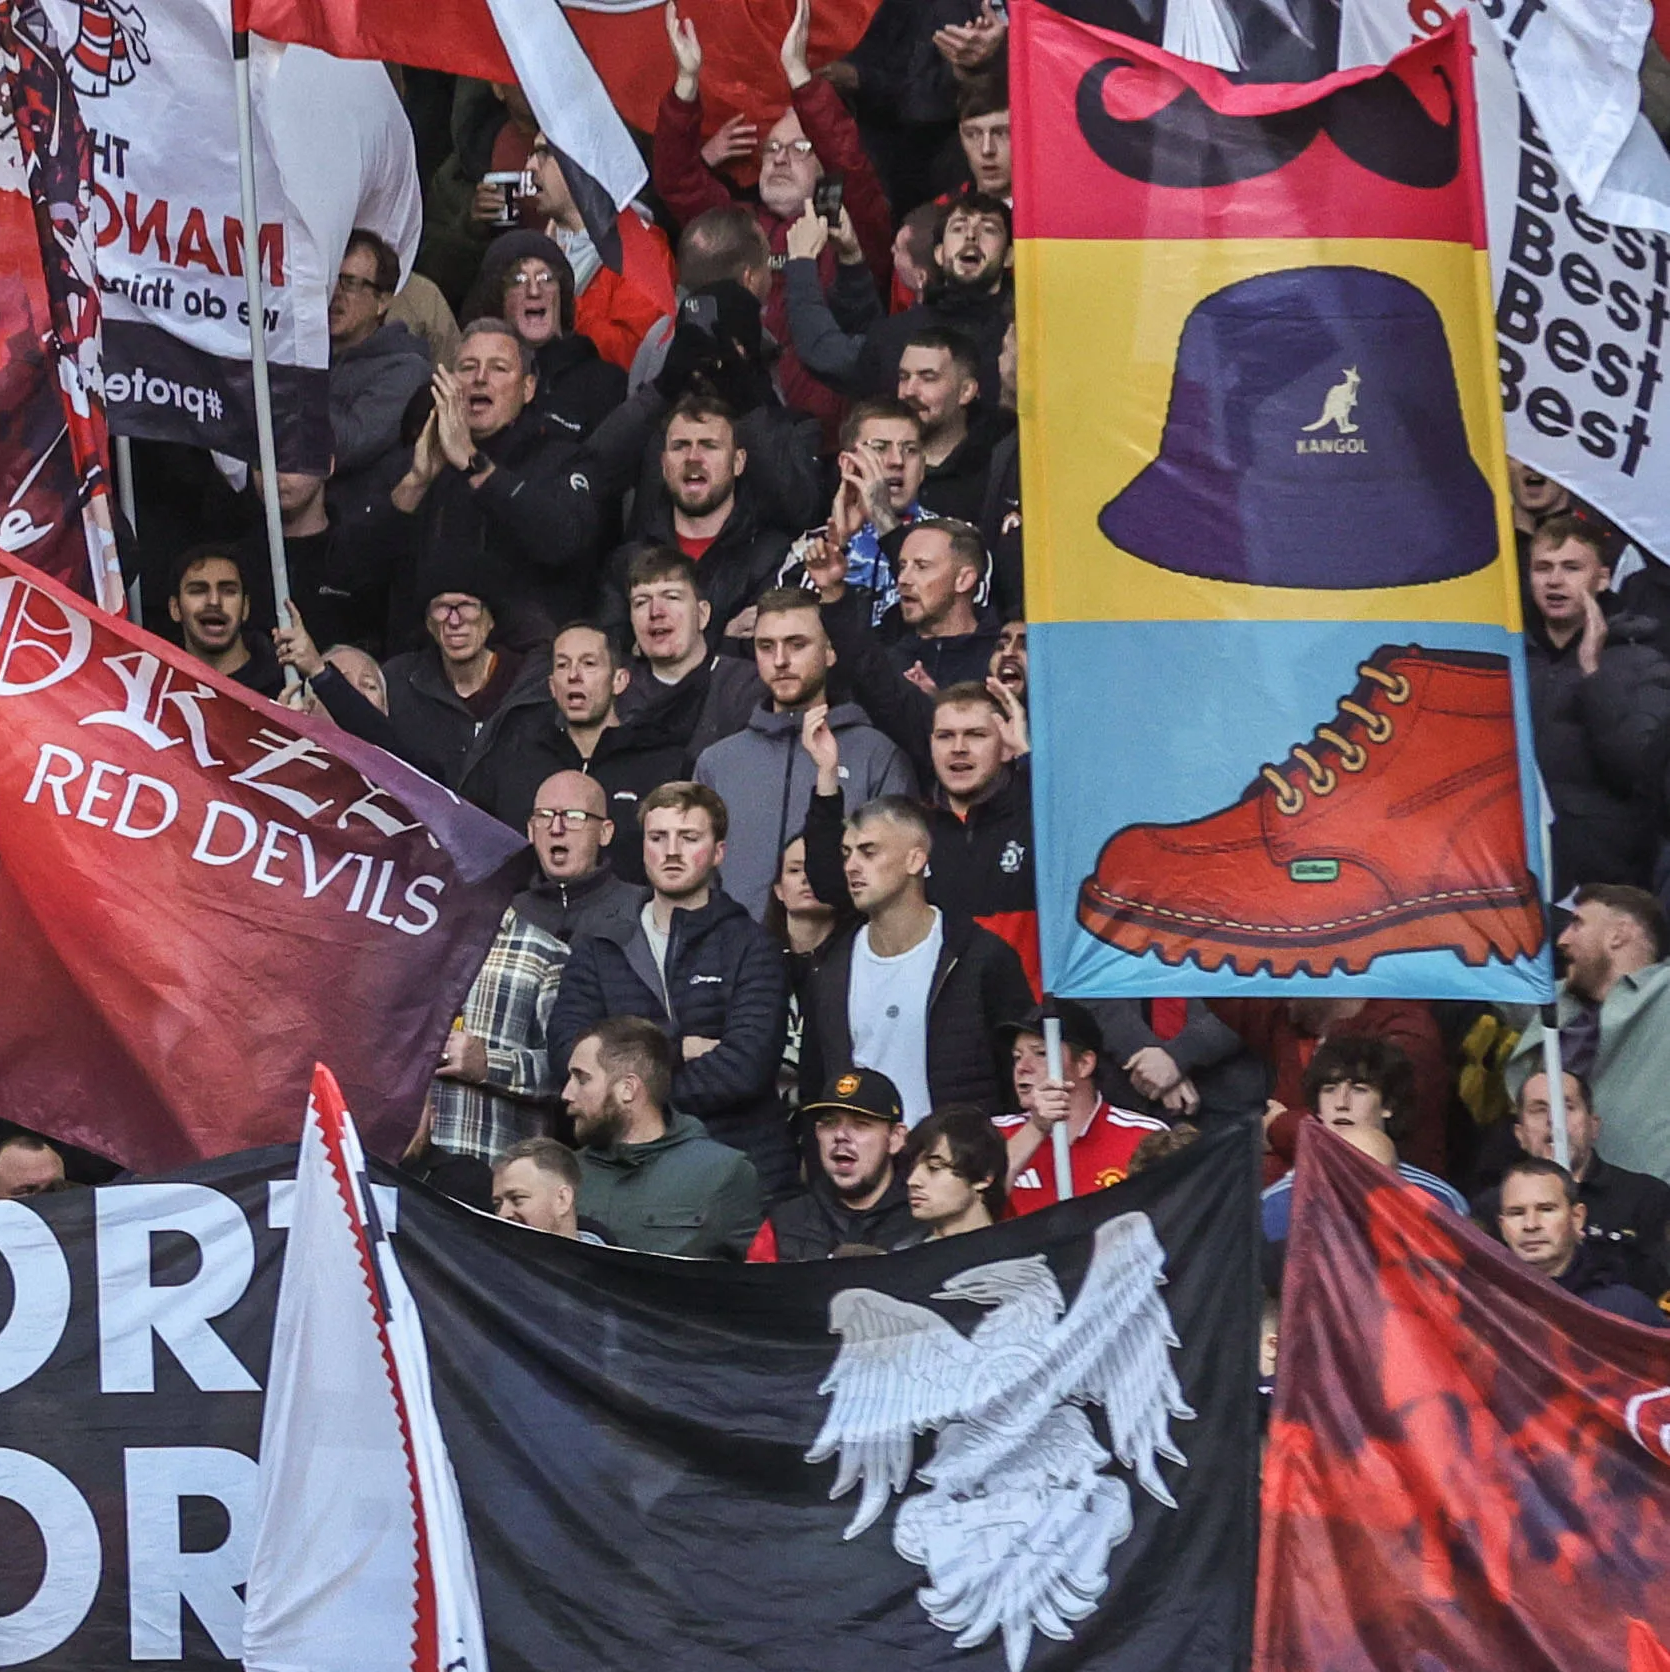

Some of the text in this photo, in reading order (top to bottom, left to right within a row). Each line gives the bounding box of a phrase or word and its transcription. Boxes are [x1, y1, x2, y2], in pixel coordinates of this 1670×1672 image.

[1496, 268, 1664, 413] Best
[1508, 205, 1670, 350] Best
[1296, 438, 1370, 455] KANGOL
[22, 742, 447, 937] RED DEVILS
